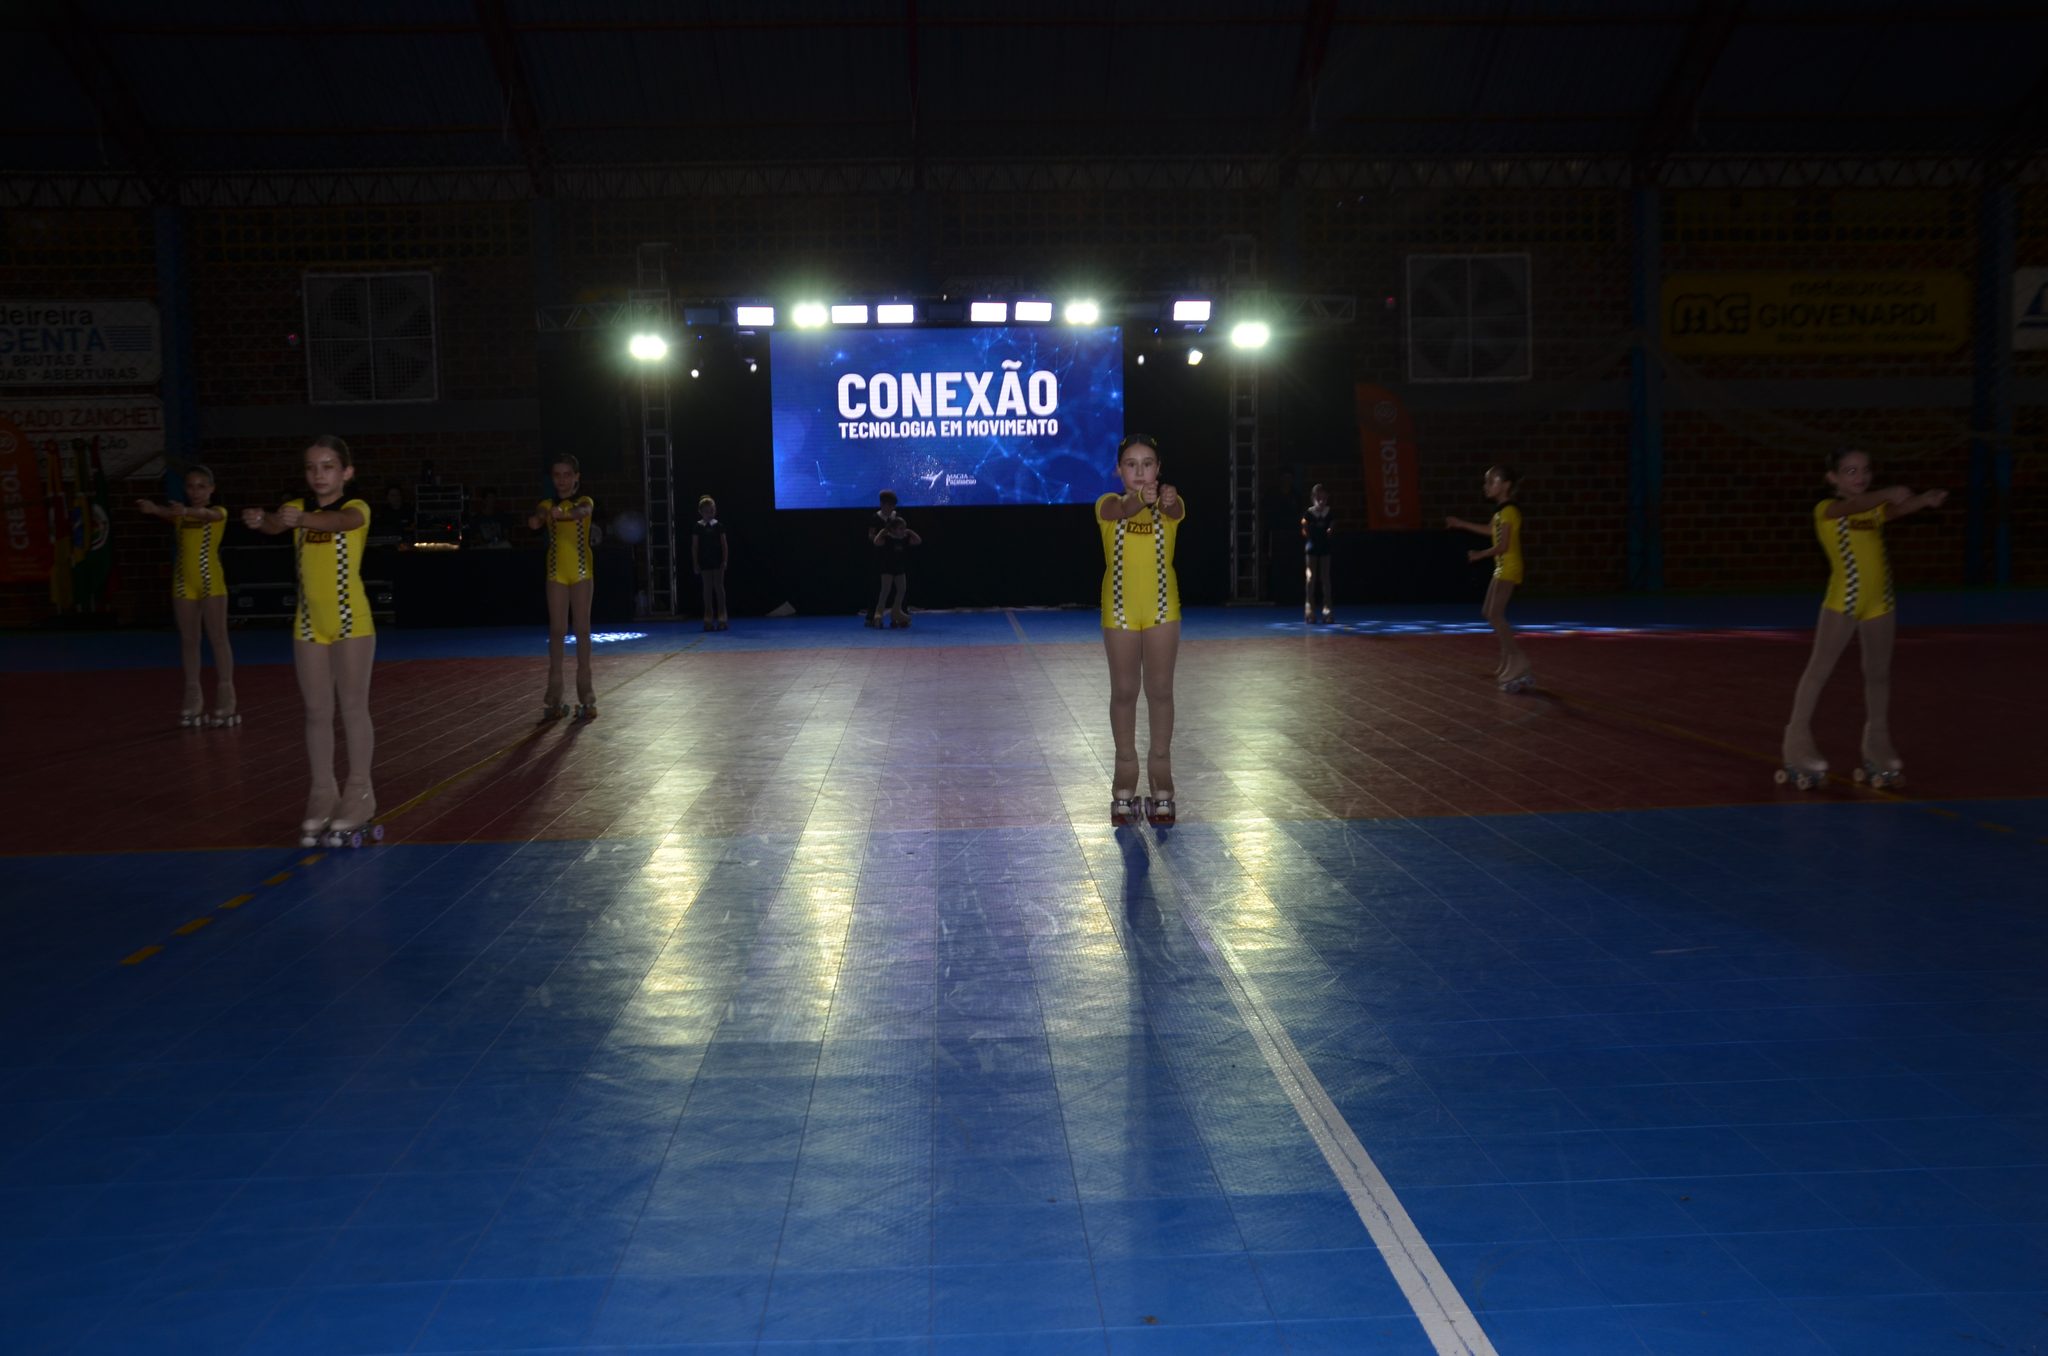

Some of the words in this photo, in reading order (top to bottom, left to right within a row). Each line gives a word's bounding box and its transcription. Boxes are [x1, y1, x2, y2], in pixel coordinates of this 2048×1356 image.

[1759, 303, 1938, 328] GIOVENARDI
[13, 354, 75, 367] BRUTAS
[43, 367, 138, 381] ABERTURAS
[838, 359, 1058, 420] CONEXÃO
[70, 406, 161, 426] ZANCHET
[838, 420, 937, 439] TECNOLOGIA
[941, 420, 963, 437] EM
[966, 418, 1059, 437] MOVIMENTO
[1379, 433, 1401, 518] CRESOL
[0, 464, 30, 550] CRESOL
[1129, 523, 1151, 534] TAXI
